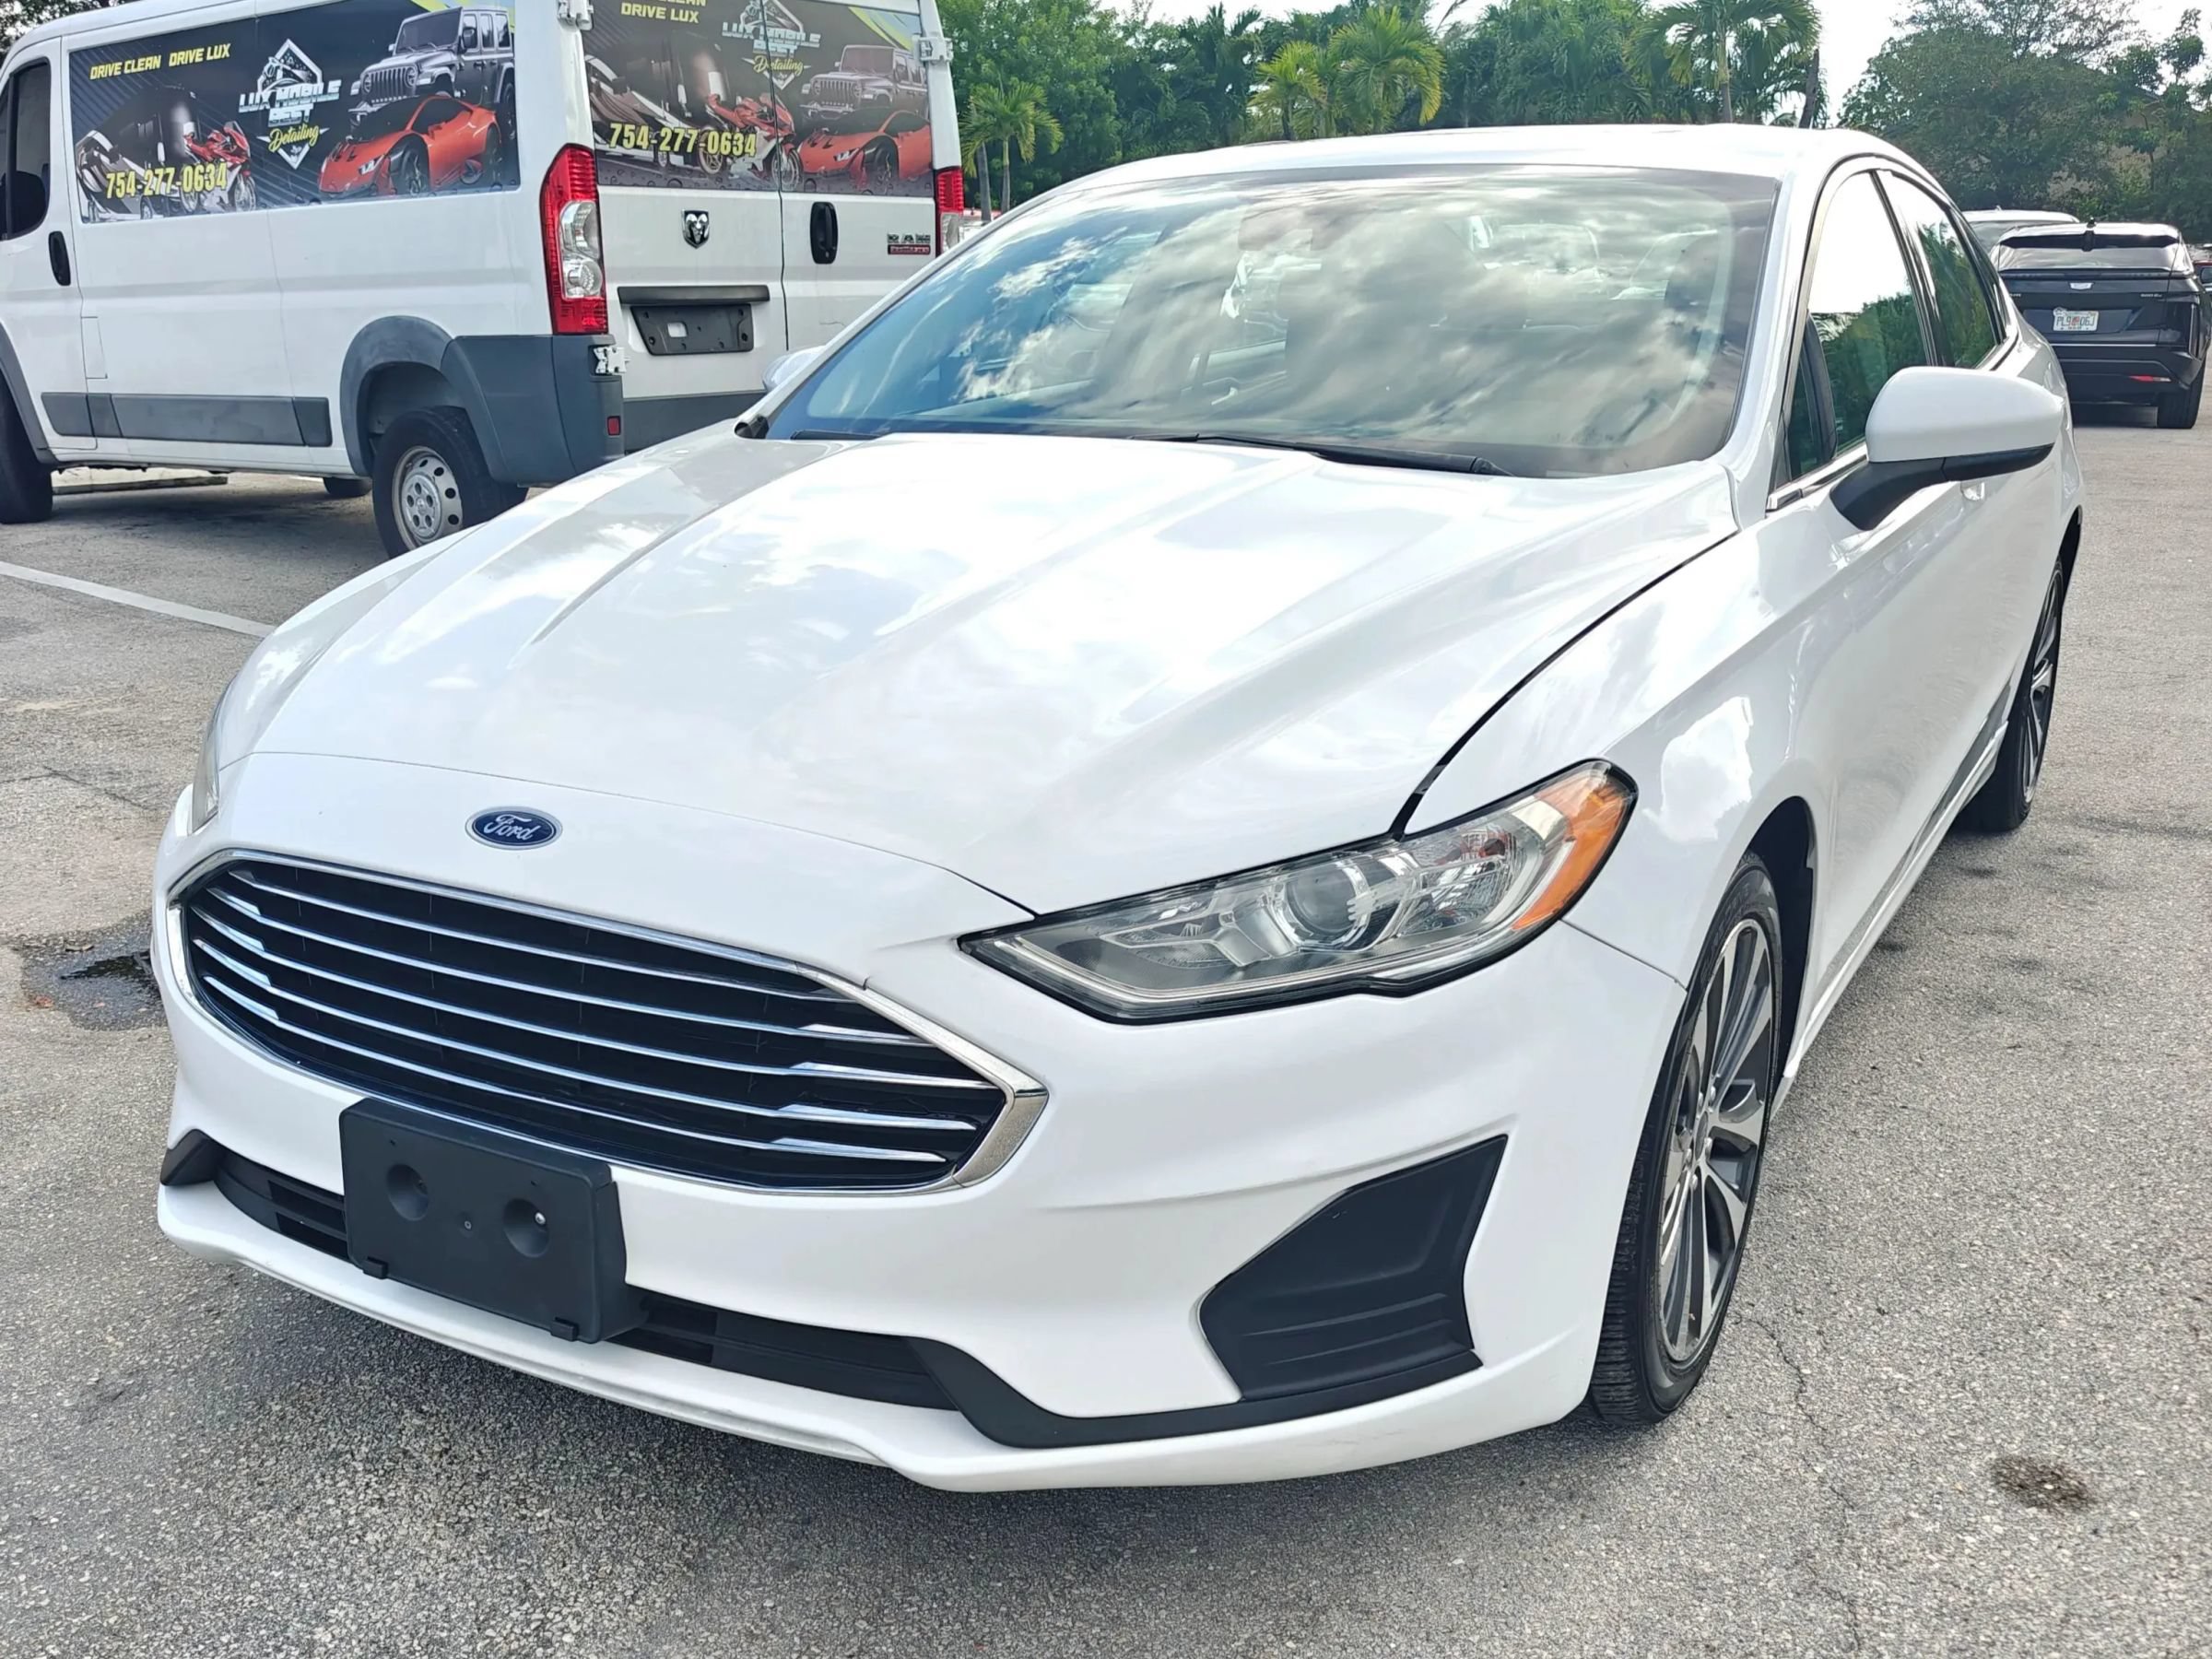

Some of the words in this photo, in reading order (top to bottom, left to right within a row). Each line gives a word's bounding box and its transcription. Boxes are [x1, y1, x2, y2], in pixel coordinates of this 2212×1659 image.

[621, 2, 667, 19] DRIVE
[670, 8, 700, 24] LUX
[722, 21, 755, 40] LUX
[89, 61, 124, 80] DRIVE
[124, 54, 162, 75] CLEAN
[169, 48, 205, 67] DRIVE
[206, 43, 231, 61] LUX
[753, 54, 804, 76] Detailing
[239, 91, 274, 112] LUX
[269, 123, 320, 153] Detailing
[609, 123, 758, 158] 754-277-0634
[106, 162, 228, 199] 754-277-0634
[483, 813, 539, 841] Ford
